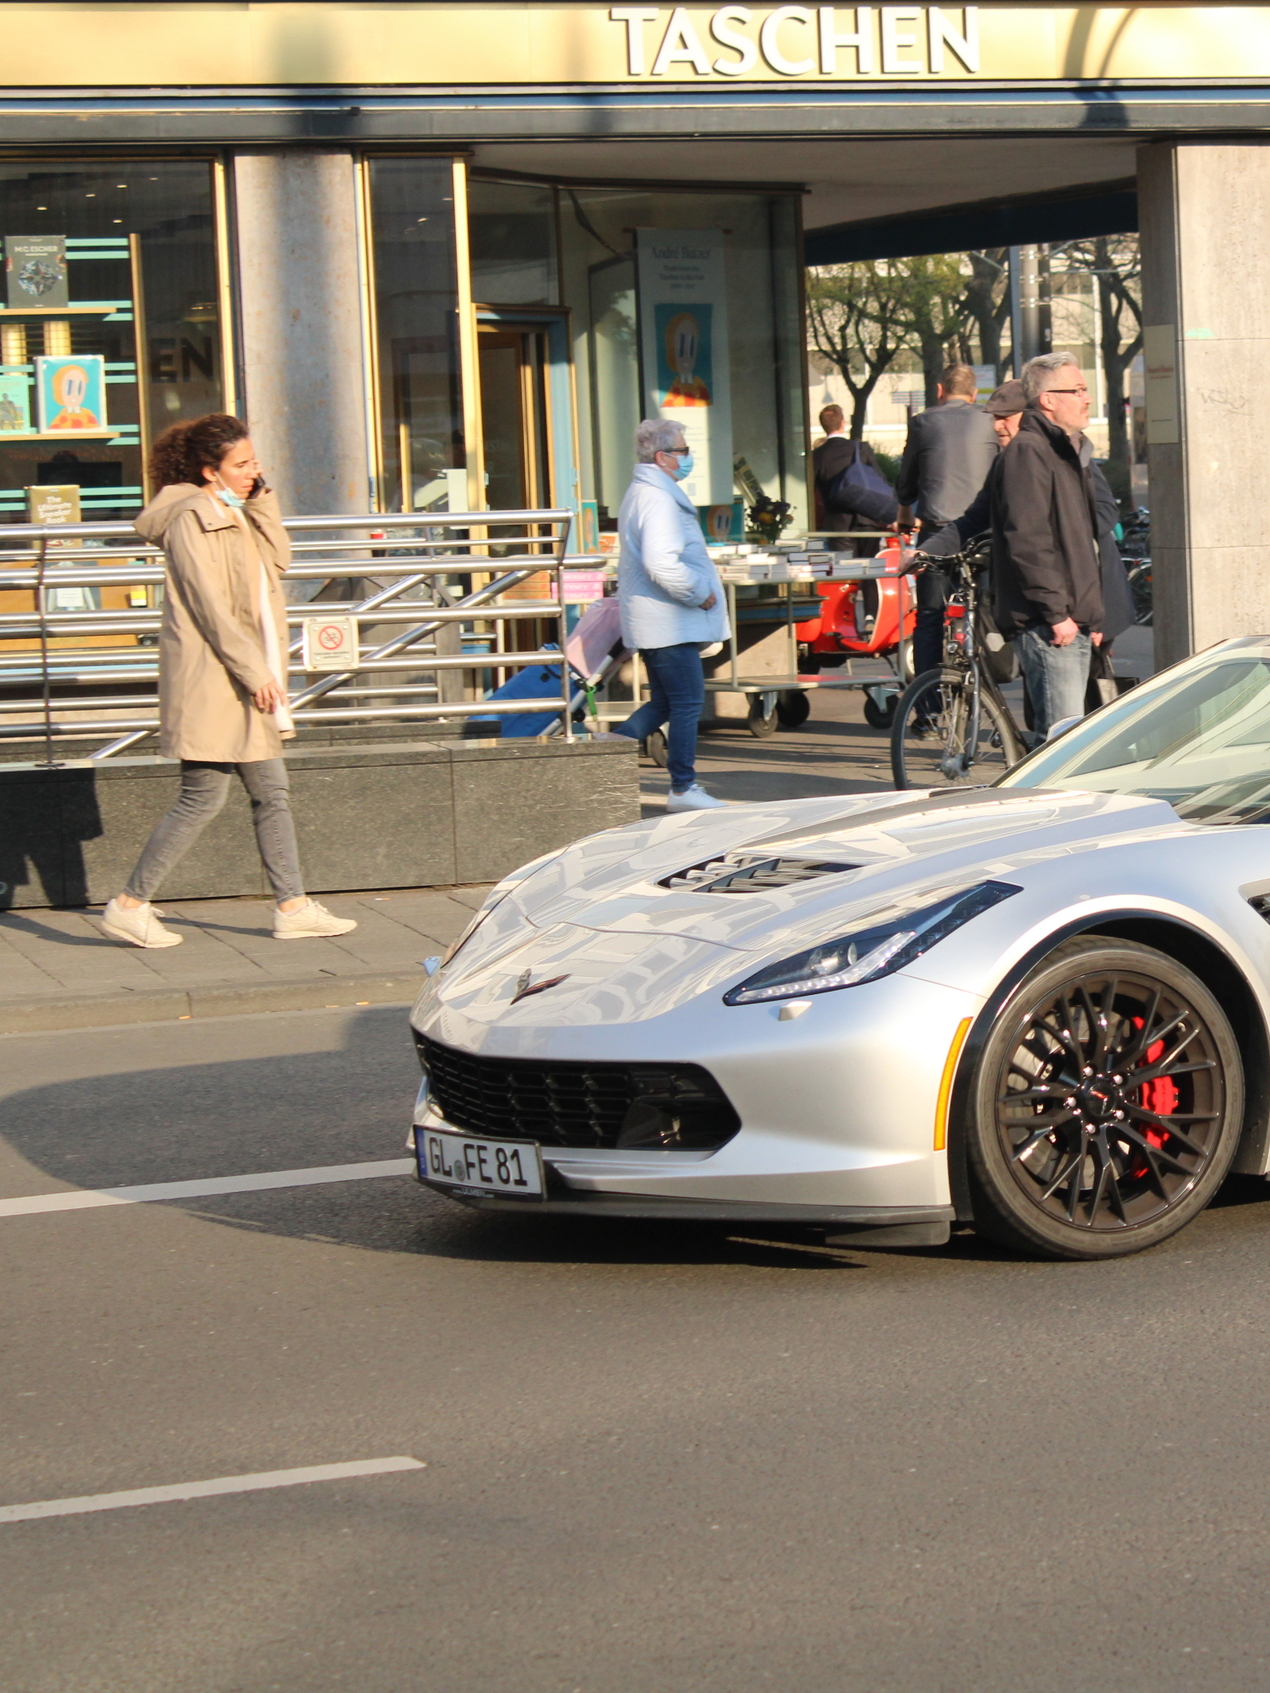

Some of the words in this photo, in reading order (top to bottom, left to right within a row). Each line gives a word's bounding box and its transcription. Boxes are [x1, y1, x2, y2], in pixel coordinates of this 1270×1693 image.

[610, 5, 980, 76] TASCHEN
[46, 496, 62, 504] The
[37, 502, 72, 512] Ultimate
[38, 509, 72, 519] Sneaker
[429, 1136, 452, 1177] GL
[463, 1143, 493, 1183] FE
[495, 1147, 528, 1187] 81
